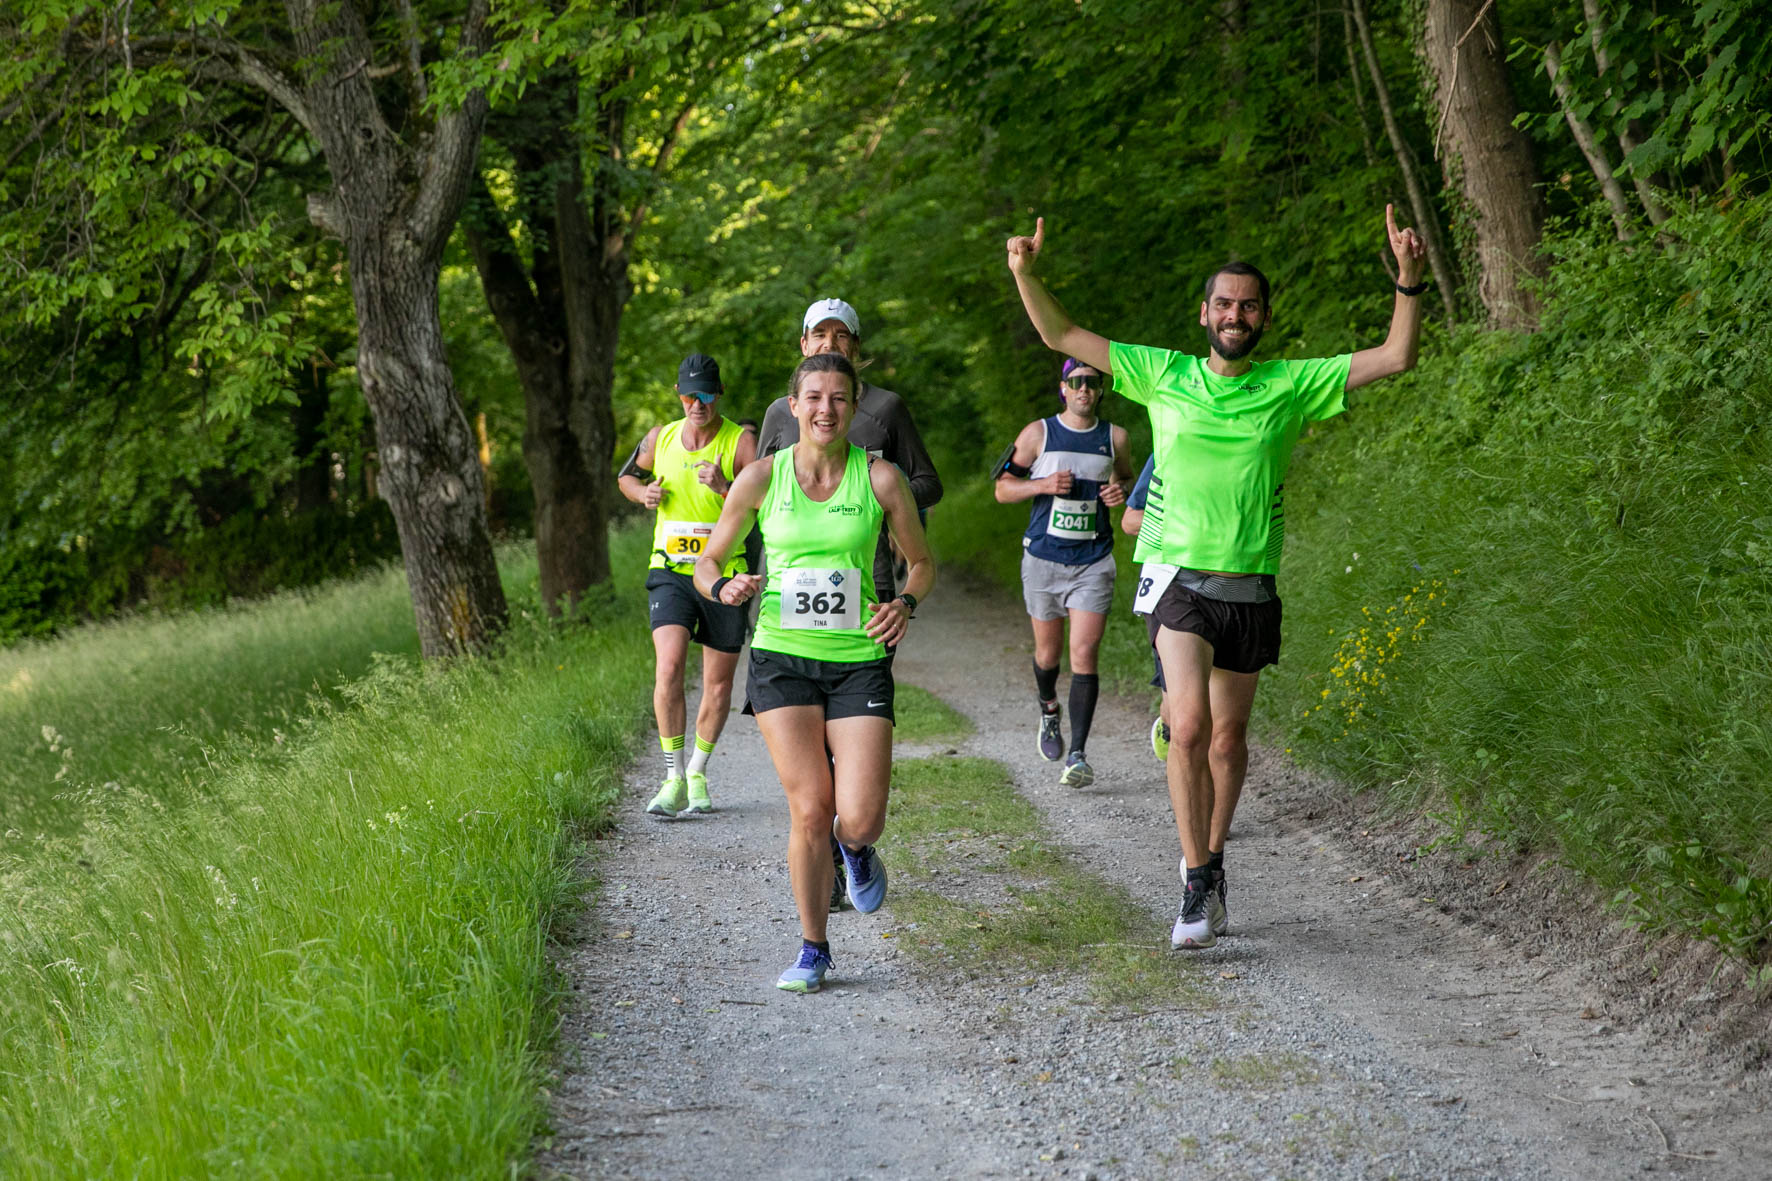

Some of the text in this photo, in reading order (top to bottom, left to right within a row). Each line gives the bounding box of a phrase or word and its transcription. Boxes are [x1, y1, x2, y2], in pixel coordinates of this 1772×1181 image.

[1055, 513, 1089, 530] 2041
[677, 538, 701, 553] 30
[795, 592, 846, 614] 362
